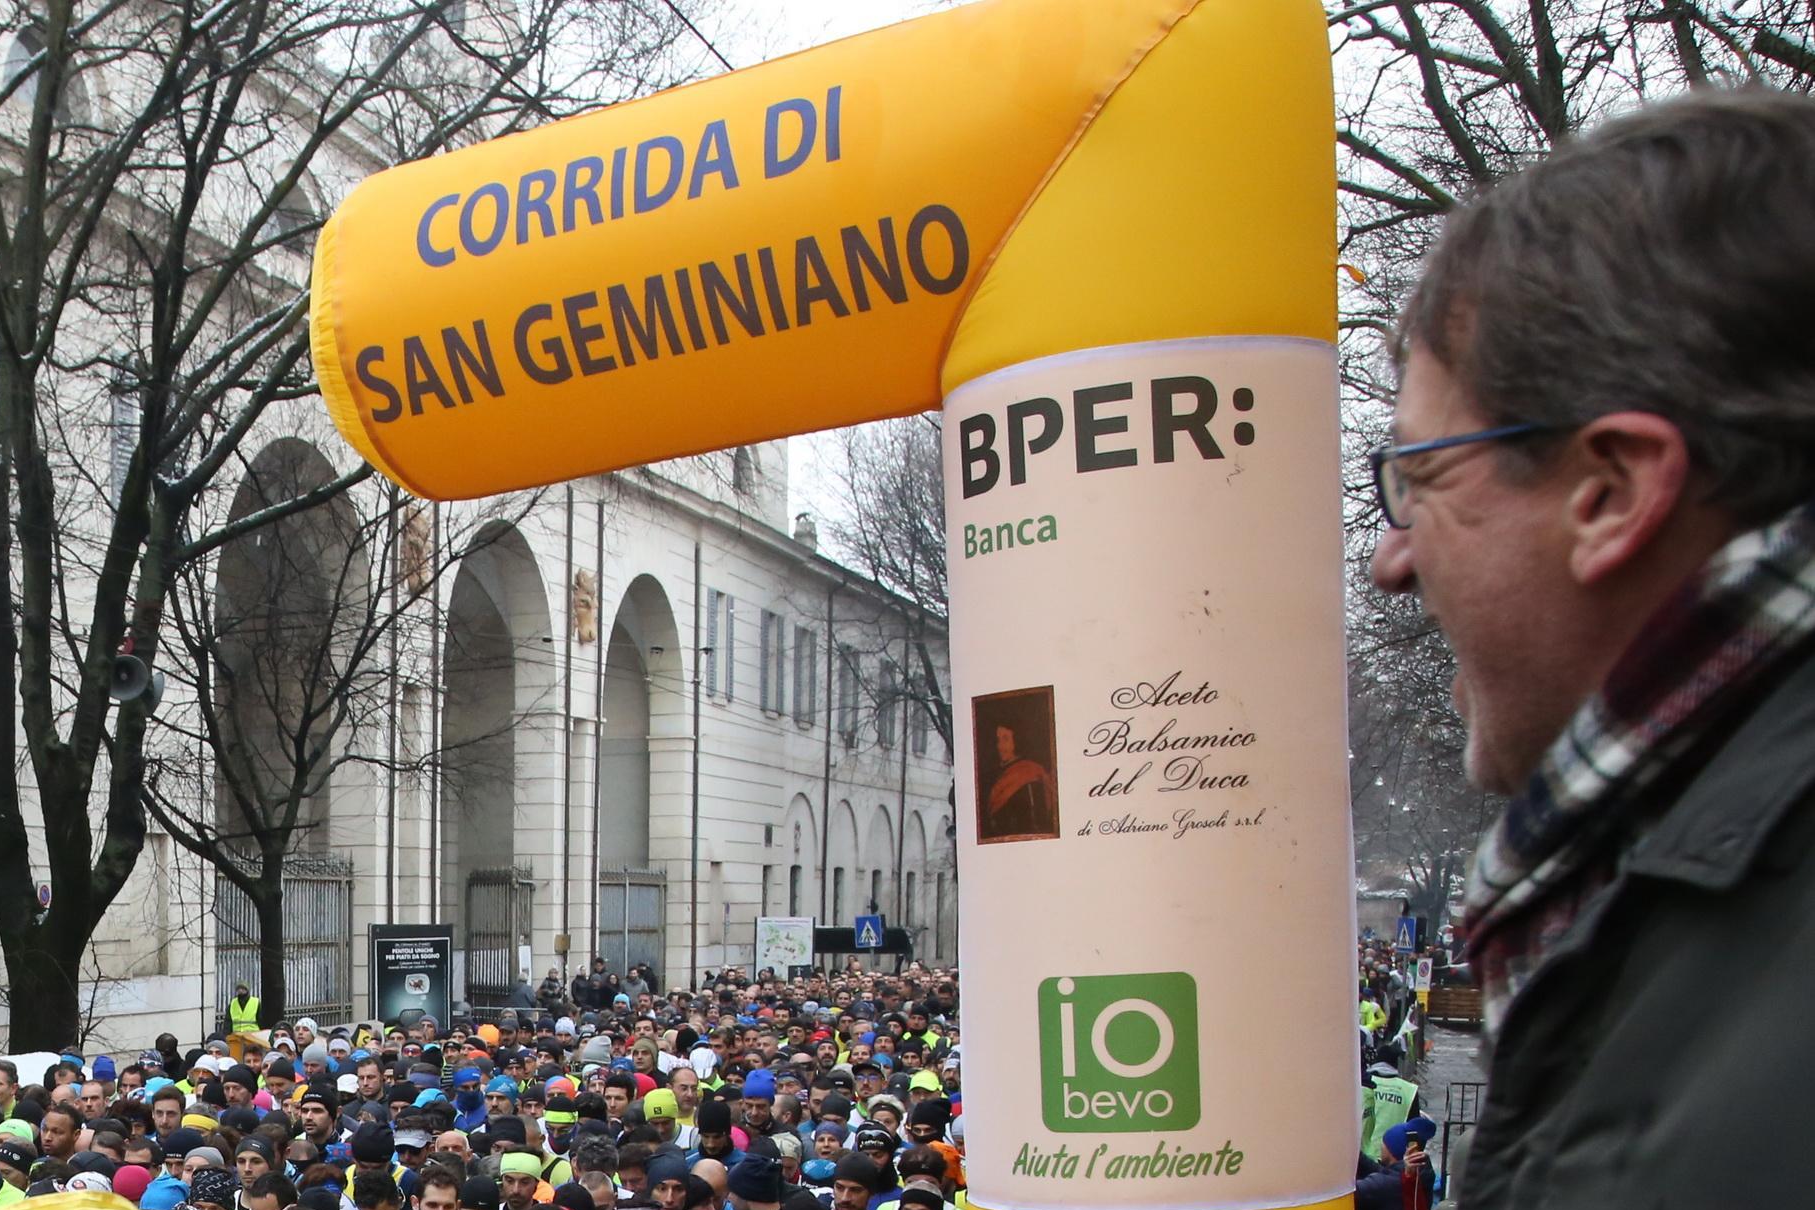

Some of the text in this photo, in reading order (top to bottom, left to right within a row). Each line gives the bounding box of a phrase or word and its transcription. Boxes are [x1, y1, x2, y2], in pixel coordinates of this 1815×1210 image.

[416, 85, 842, 267] CORRIDA DI
[356, 204, 970, 423] SAN GEMINIANO
[964, 515, 1057, 559] Banca
[1111, 671, 1218, 709] Aceto
[1084, 717, 1256, 757] Balsamico
[1089, 756, 1249, 798] del Duca
[1078, 823, 1093, 837] di
[1098, 813, 1168, 835] Adriano
[1057, 977, 1174, 1078] io
[1063, 1083, 1173, 1119] bevo
[1012, 1142, 1079, 1179] Aiuta
